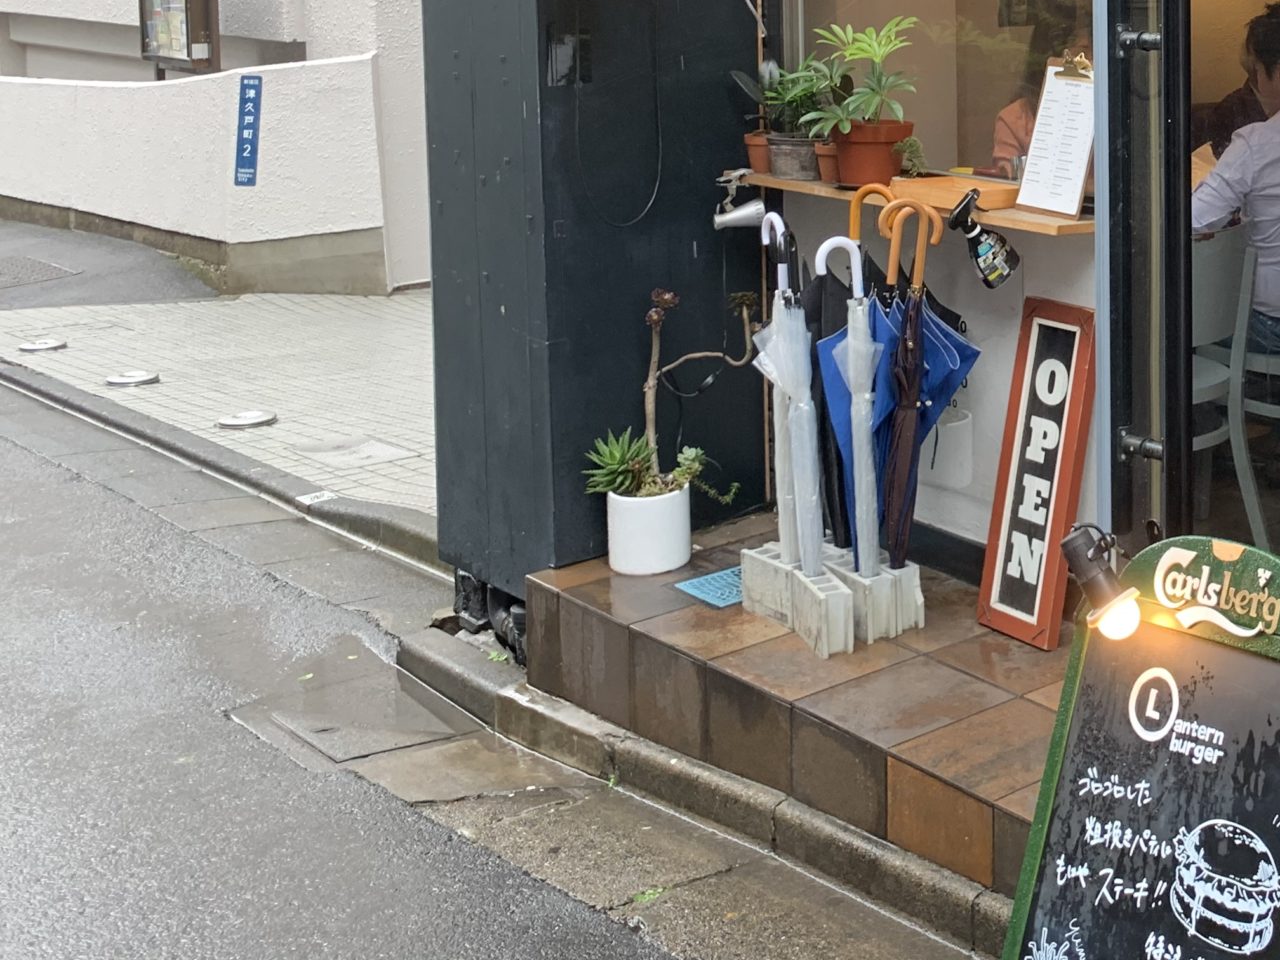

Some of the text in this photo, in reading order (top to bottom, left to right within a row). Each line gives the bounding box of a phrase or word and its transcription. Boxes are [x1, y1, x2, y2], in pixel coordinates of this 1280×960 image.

[1007, 358, 1069, 586] OPEN
[1169, 732, 1224, 765] burger
[1078, 766, 1152, 807] ゴロゴロした
